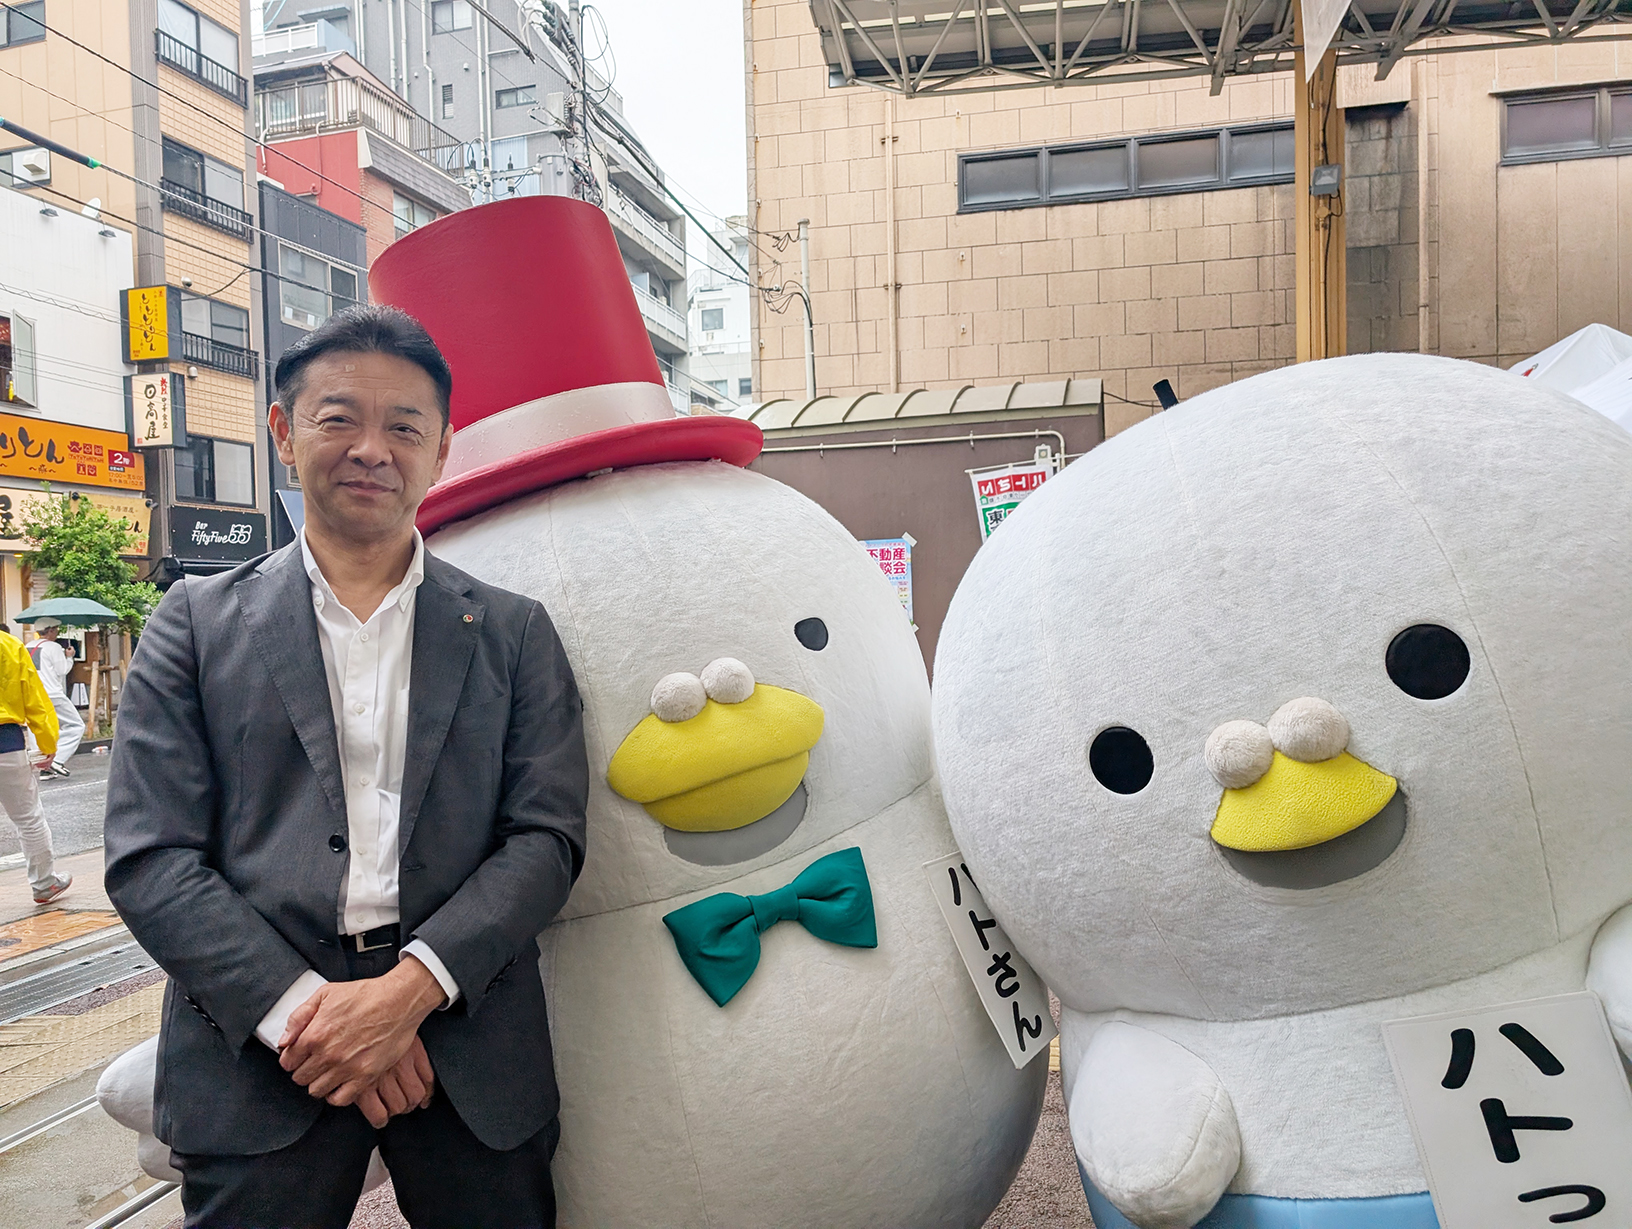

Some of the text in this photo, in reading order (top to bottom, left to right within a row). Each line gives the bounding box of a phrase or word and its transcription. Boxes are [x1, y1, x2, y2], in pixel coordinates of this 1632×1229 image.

[144, 383, 160, 441] 日高屋
[866, 547, 906, 561] 不動産
[876, 561, 906, 575] 談会
[948, 862, 1042, 1053] ハトさん
